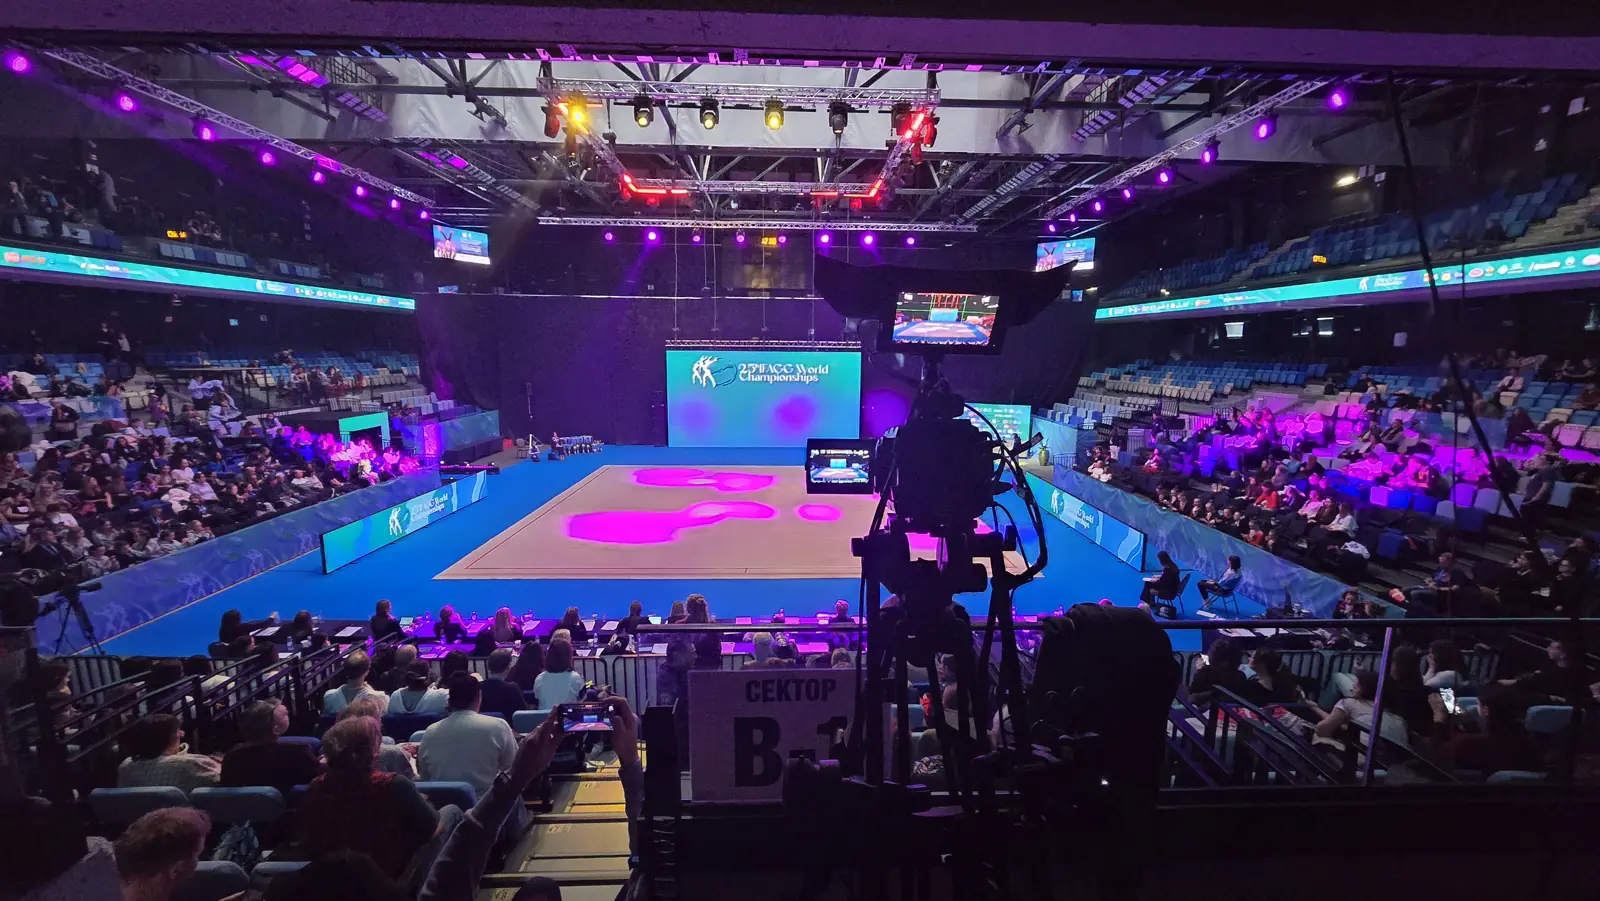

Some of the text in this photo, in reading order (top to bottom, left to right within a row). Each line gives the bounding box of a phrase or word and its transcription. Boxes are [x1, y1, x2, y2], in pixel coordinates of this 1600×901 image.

[795, 363, 829, 375] World
[739, 371, 819, 384] Championships
[745, 678, 837, 703] СЕКТОР
